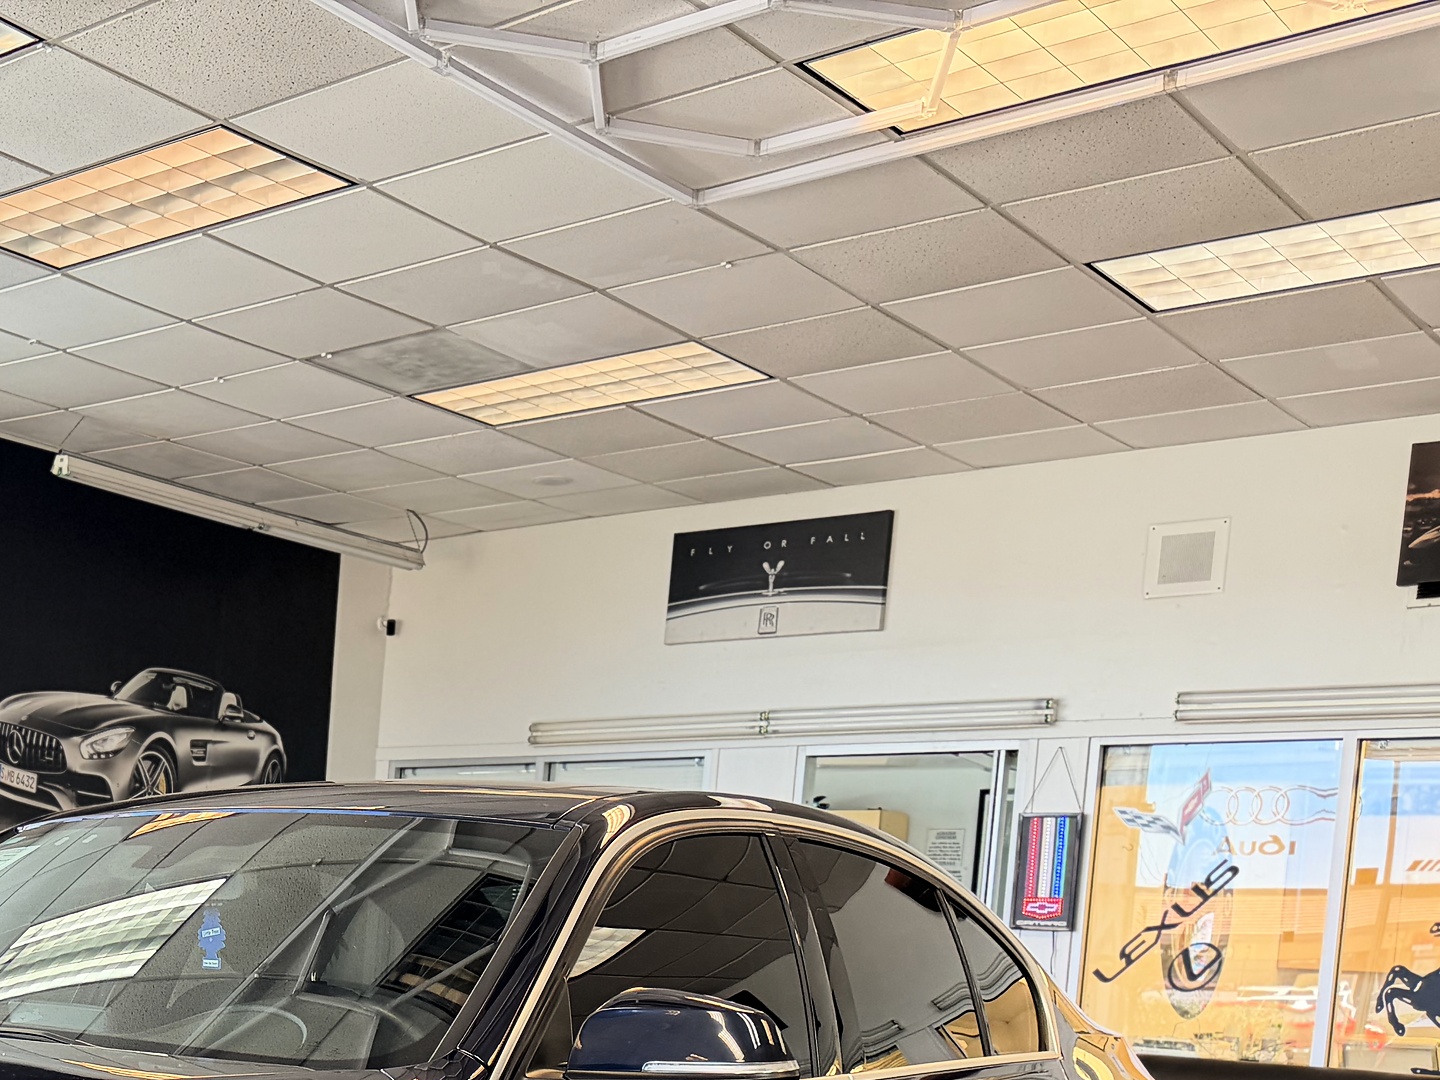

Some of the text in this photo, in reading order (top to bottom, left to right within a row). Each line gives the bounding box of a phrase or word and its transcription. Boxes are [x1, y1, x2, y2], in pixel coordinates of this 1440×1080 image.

[690, 532, 865, 557] FLY OR FALL
[15, 772, 36, 790] 6432
[1092, 858, 1240, 983] LEXUS
